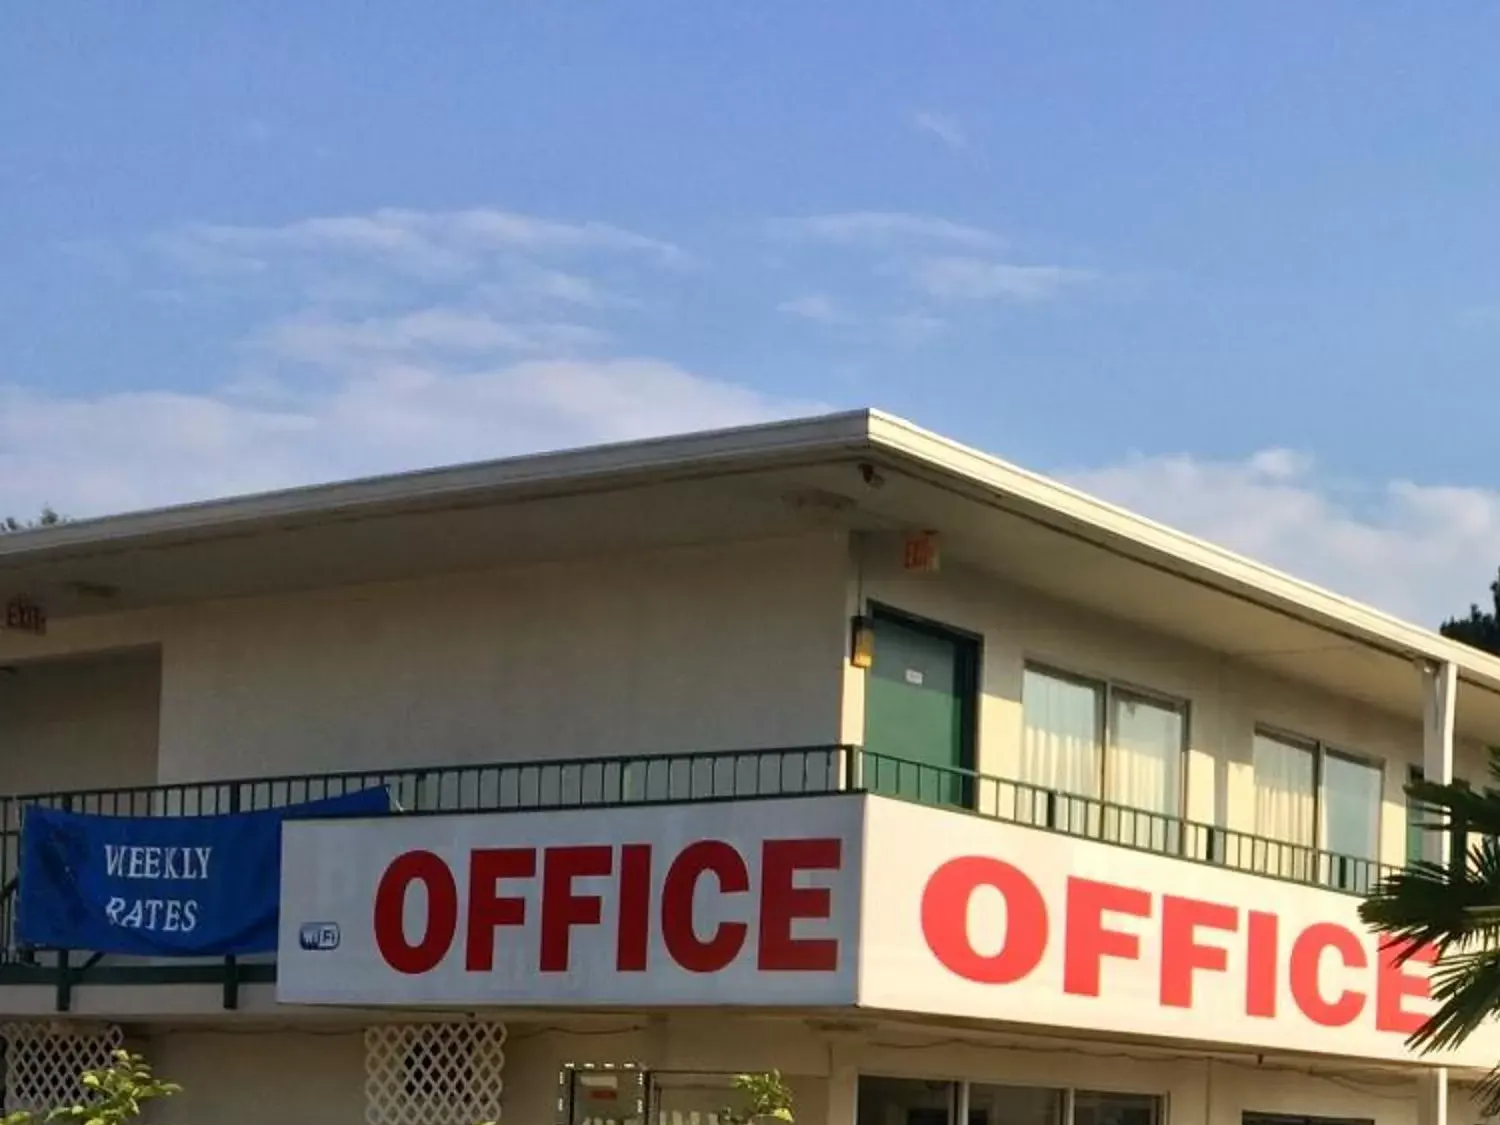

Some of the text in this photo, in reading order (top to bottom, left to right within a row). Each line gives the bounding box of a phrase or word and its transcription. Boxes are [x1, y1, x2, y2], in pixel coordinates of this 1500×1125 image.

[104, 844, 212, 879] WEEKLY
[105, 896, 198, 932] RATES
[374, 838, 843, 975] OFFICE
[921, 857, 1442, 1036] OFFICE
